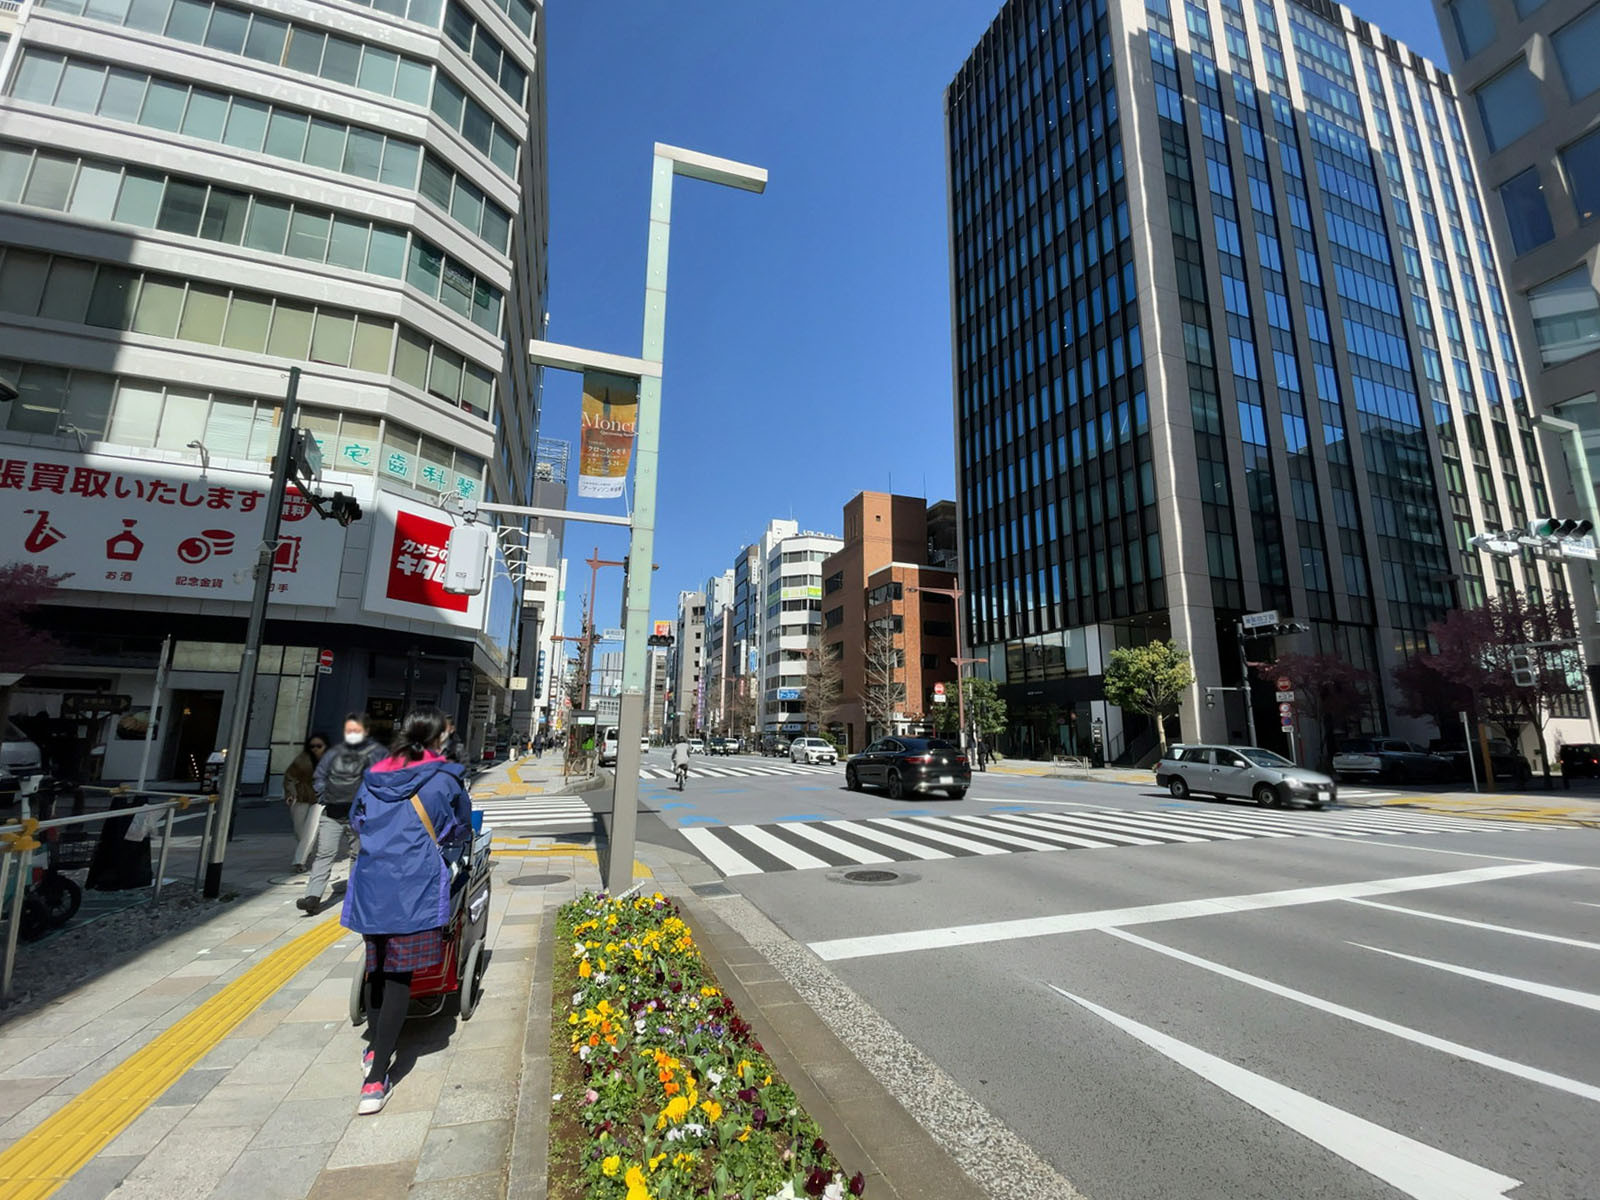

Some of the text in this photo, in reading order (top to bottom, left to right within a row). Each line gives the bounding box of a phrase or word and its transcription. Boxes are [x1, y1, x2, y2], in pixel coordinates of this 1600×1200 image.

[0, 457, 265, 513] 張買取いたします
[105, 571, 133, 582] お酒
[175, 576, 223, 588] 記念金貨
